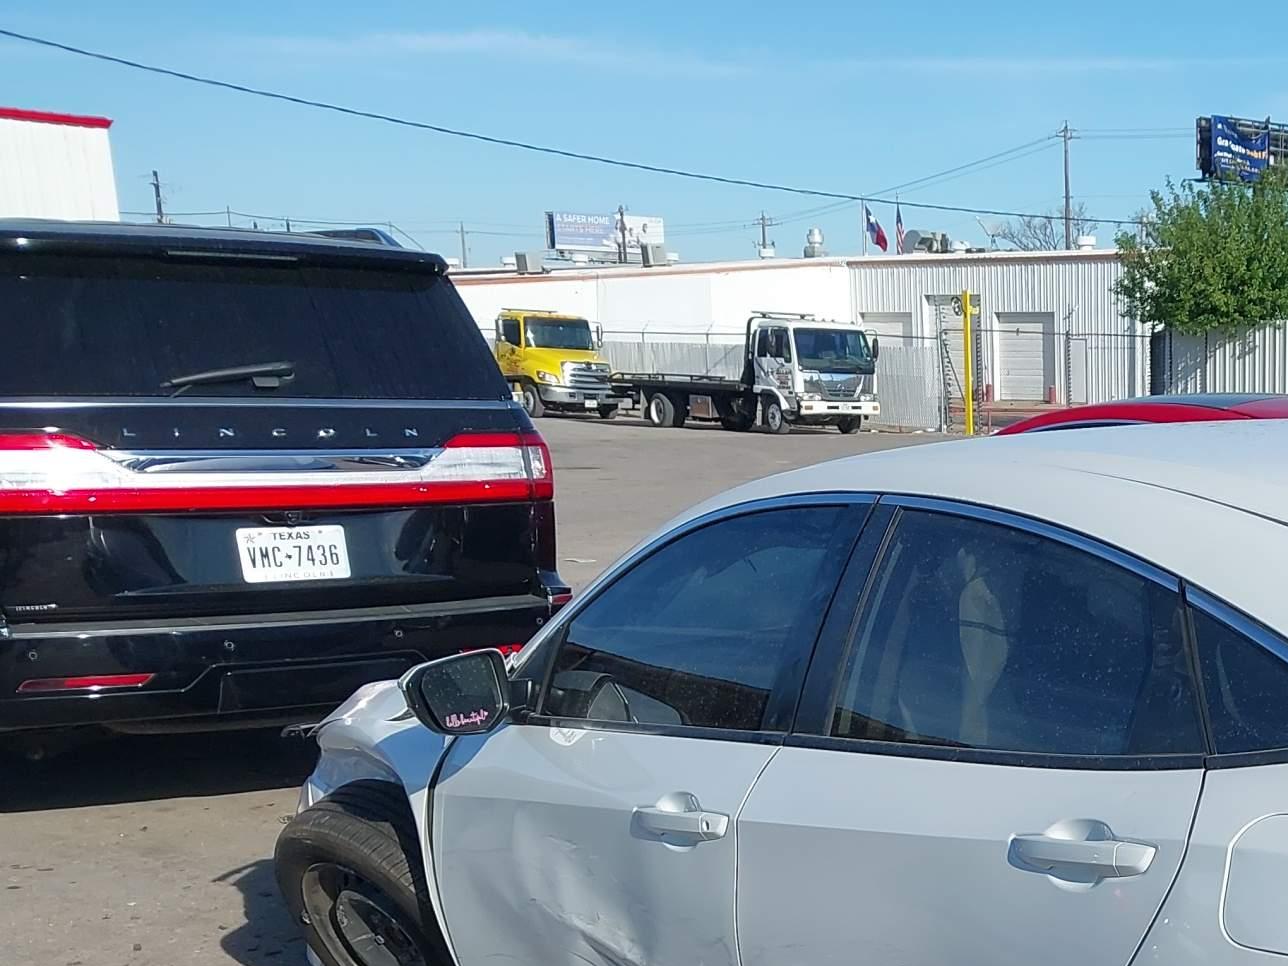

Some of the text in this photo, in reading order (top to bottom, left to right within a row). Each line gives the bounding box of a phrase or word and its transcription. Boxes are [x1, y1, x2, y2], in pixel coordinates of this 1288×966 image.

[556, 213, 610, 225] A SAFER HOME
[122, 427, 419, 438] LINCOLN
[272, 530, 311, 541] TEXAS
[247, 544, 340, 568] VMC 7436
